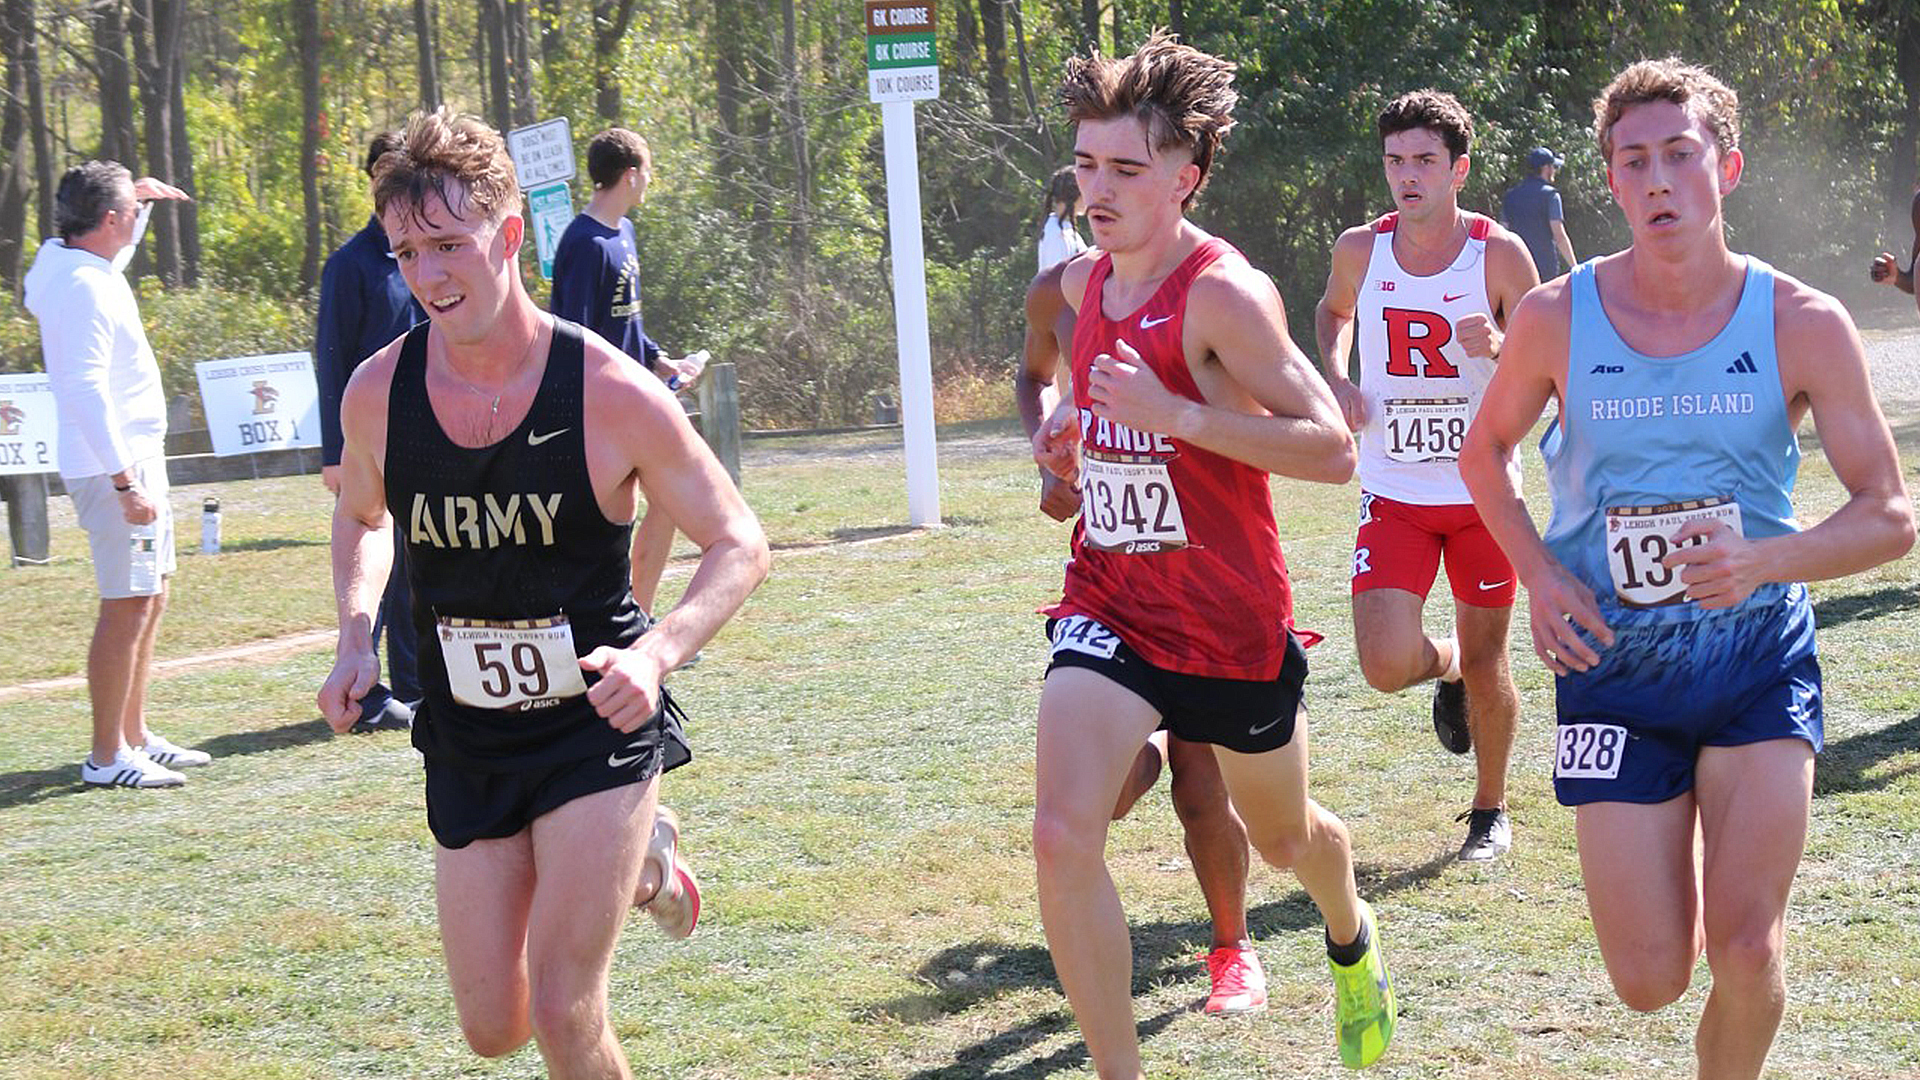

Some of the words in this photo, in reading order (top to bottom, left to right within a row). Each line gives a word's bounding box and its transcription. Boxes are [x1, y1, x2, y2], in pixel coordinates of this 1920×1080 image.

[873, 9, 888, 26] 6K
[890, 7, 929, 25] COURSE
[875, 43, 890, 61] 8K
[892, 41, 931, 60] COURSE
[876, 77, 893, 94] 10K
[896, 74, 934, 93] COURSE
[1382, 307, 1460, 378] R
[267, 361, 306, 373] COUNTRY
[1591, 396, 1664, 420] RHODE
[1672, 393, 1754, 415] ISLAND
[238, 420, 283, 446] BOX
[291, 419, 300, 440] 1
[1387, 417, 1465, 453] 1458
[35, 441, 50, 464] 2
[1084, 478, 1177, 534] 1342
[411, 493, 563, 549] ARMY
[1624, 519, 1656, 530] LEHIGH
[1659, 517, 1682, 527] PAUL
[1715, 508, 1734, 518] RUN
[1136, 541, 1161, 552] asics
[1354, 548, 1372, 575] R
[474, 642, 549, 698] 59
[533, 698, 561, 709] asics
